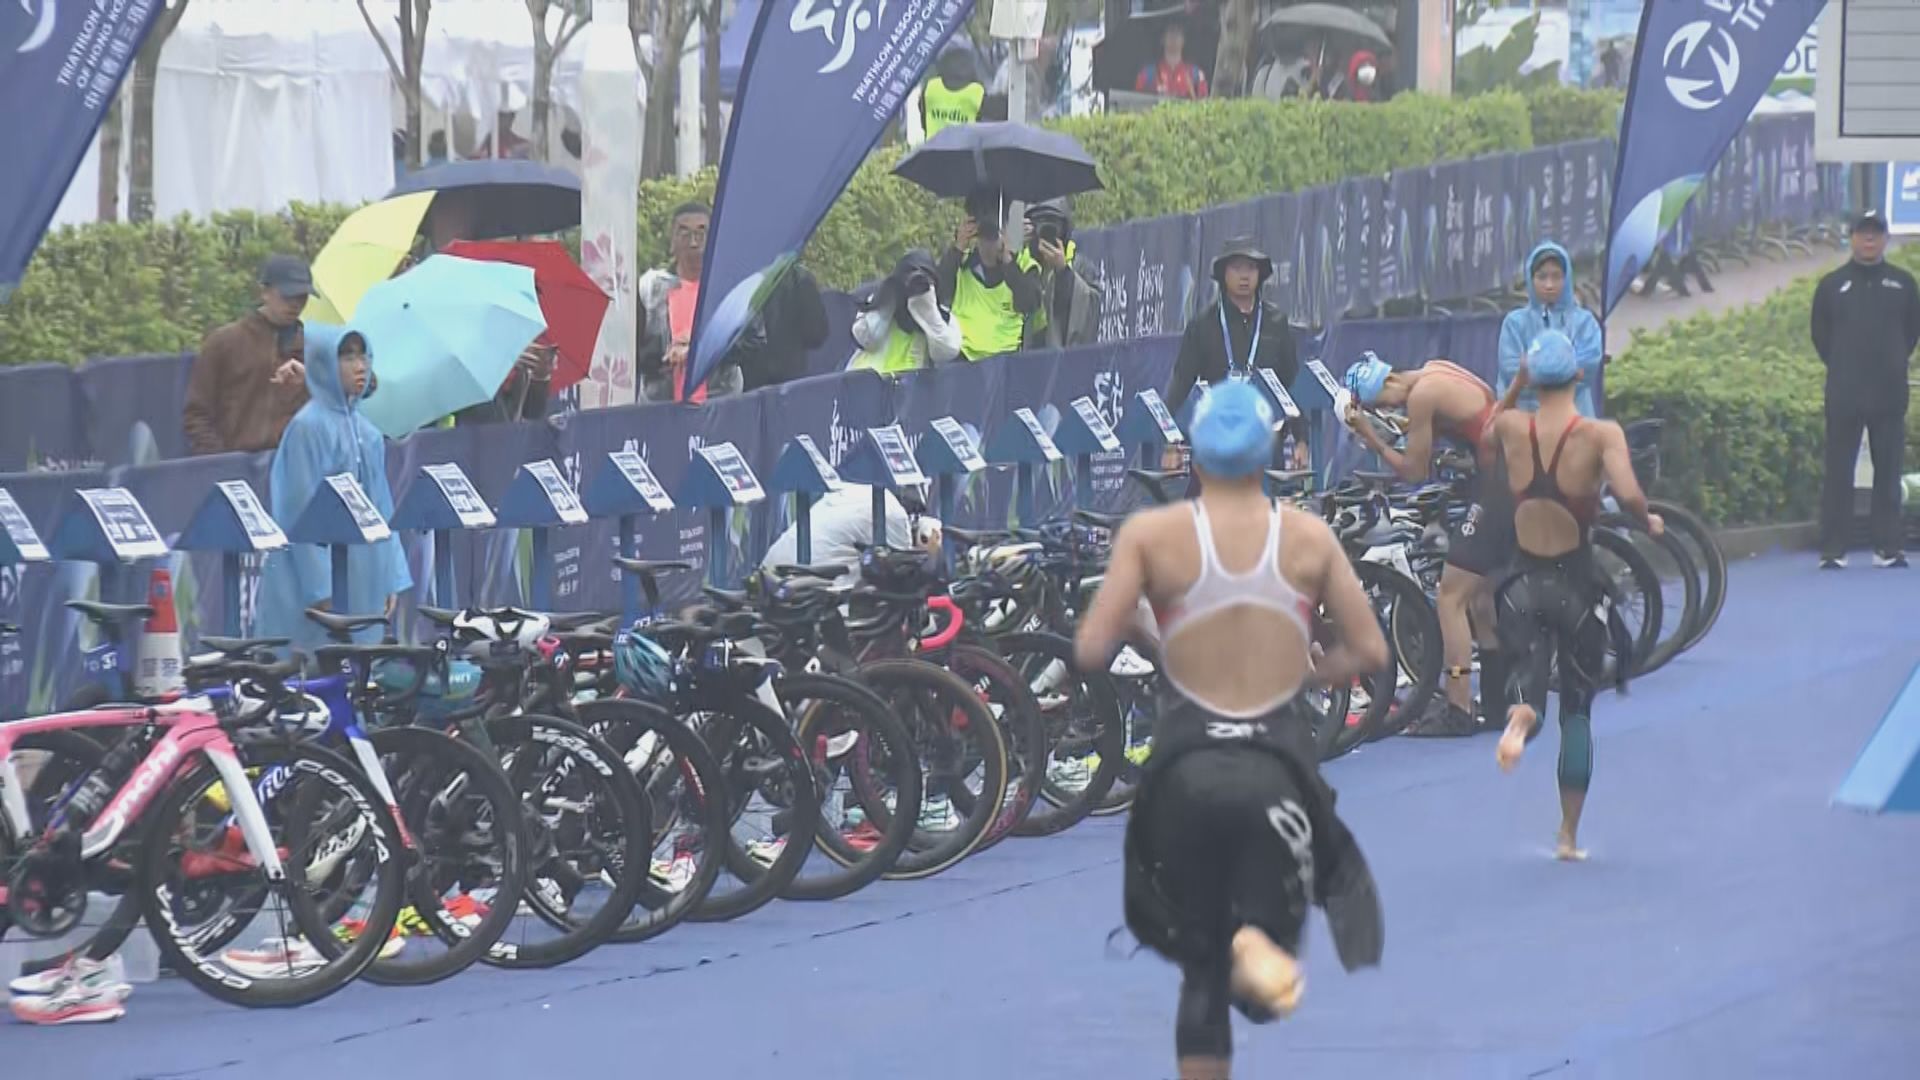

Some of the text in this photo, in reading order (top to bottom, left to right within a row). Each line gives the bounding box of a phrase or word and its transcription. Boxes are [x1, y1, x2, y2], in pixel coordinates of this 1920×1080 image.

[56, 9, 101, 86] TRIATHLON
[76, 66, 91, 89] OF
[86, 23, 113, 67] HONG
[852, 40, 894, 102] TRIATHLON
[878, 53, 902, 88] HONG
[899, 20, 924, 54] KONG
